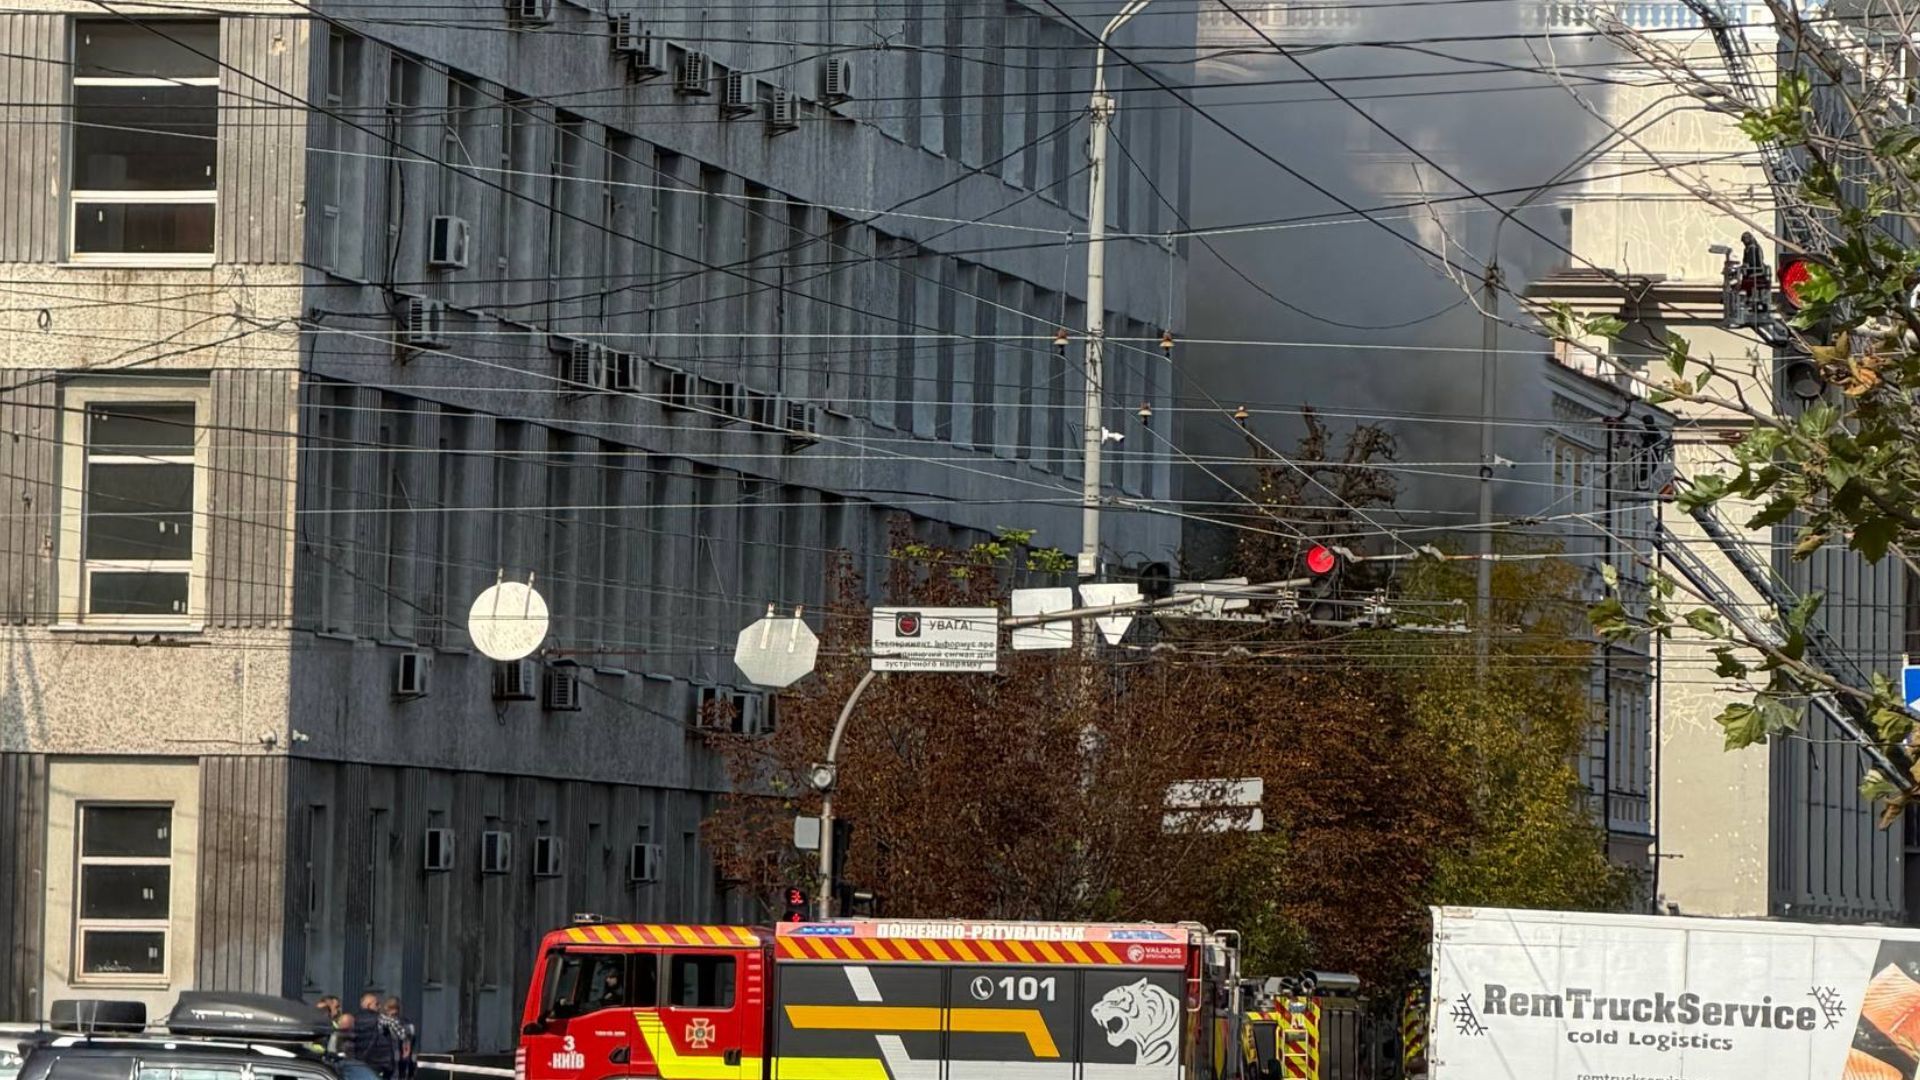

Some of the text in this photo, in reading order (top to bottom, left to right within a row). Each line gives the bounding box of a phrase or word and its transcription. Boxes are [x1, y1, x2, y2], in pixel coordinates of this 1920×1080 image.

[876, 922, 1085, 941] ПОЖЕЖНО-РЯТУВАЛЬНА
[1145, 946, 1181, 954] VALIDUS
[998, 976, 1056, 1001] 101
[1482, 983, 1817, 1031] RemTruckService
[563, 1036, 575, 1050] 3
[1567, 1029, 1733, 1052] cold Logistics
[552, 1051, 585, 1070] КИЇВ
